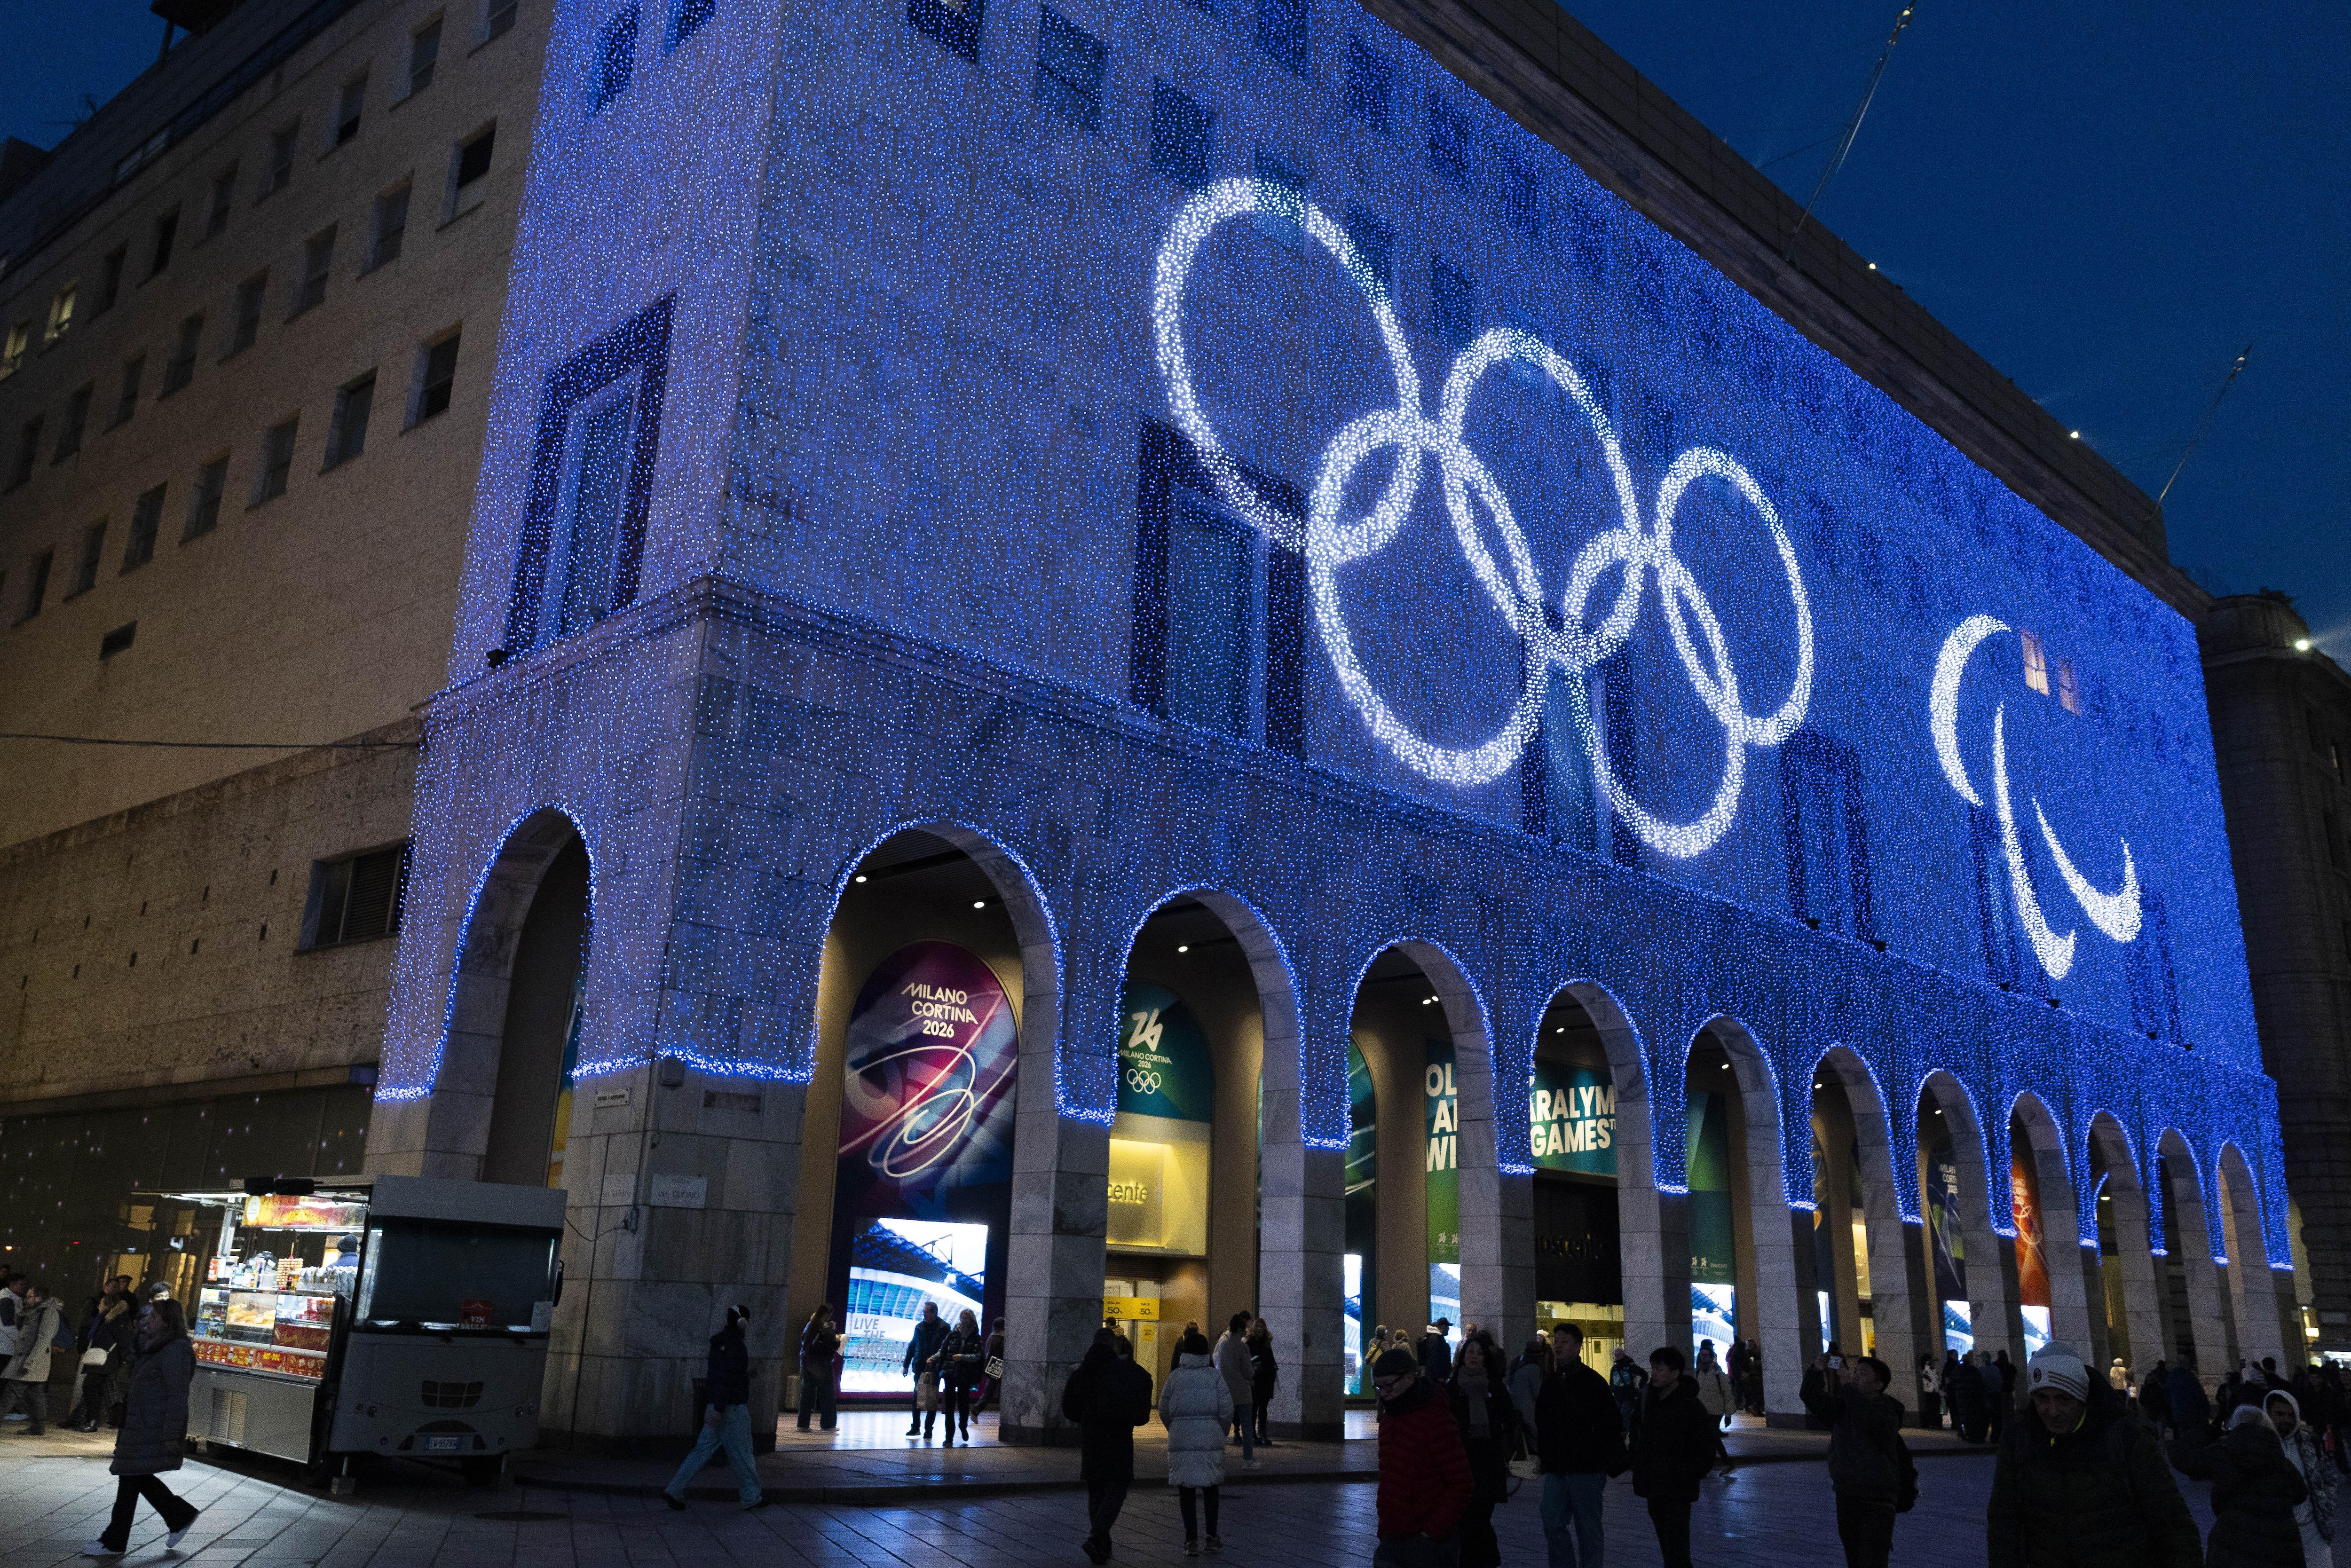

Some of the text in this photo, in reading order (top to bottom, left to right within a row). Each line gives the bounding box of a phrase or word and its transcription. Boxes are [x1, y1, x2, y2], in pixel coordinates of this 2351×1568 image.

[900, 982, 967, 1005] MILANO
[912, 1001, 978, 1024] CORTINA
[923, 1019, 955, 1038] 2026
[1138, 1060, 1152, 1069] 2026
[1145, 1054, 1172, 1064] CORTINA
[854, 1318, 879, 1330] LIVE
[864, 1330, 885, 1342] THE
